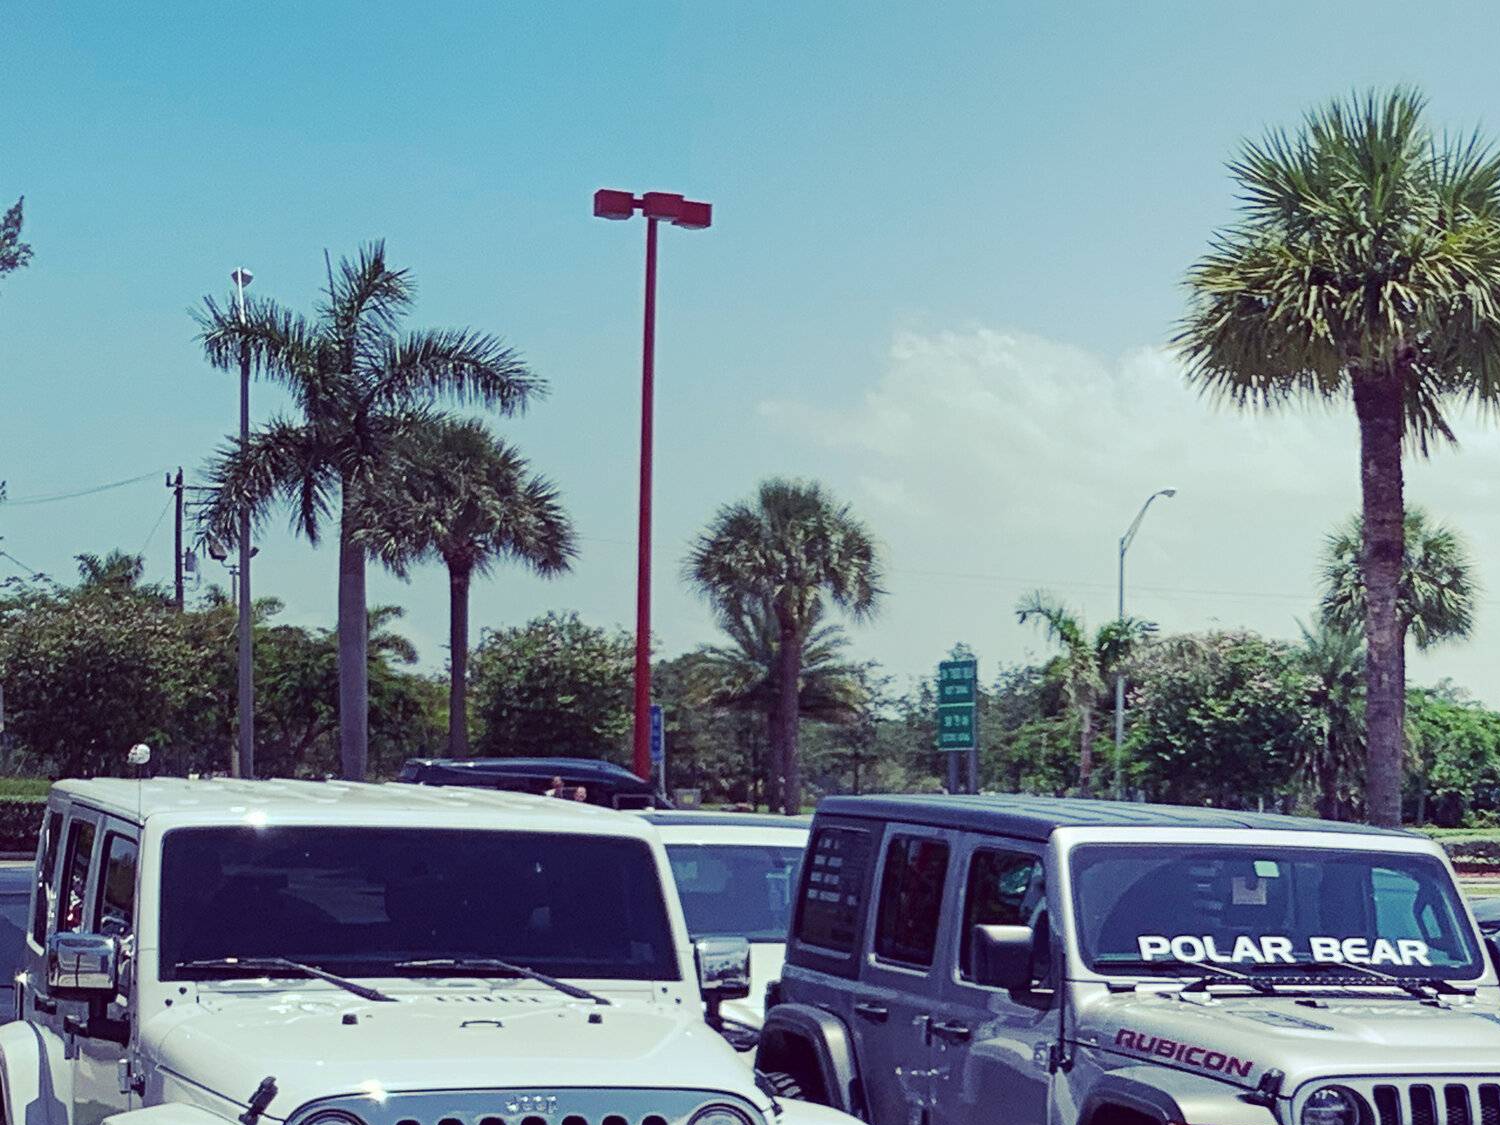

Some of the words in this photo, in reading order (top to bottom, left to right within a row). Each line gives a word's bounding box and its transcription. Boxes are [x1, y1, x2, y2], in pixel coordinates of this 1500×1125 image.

[1137, 935, 1296, 964] POLAR
[1310, 936, 1432, 966] BEAR
[1114, 1028, 1255, 1077] RUBICON
